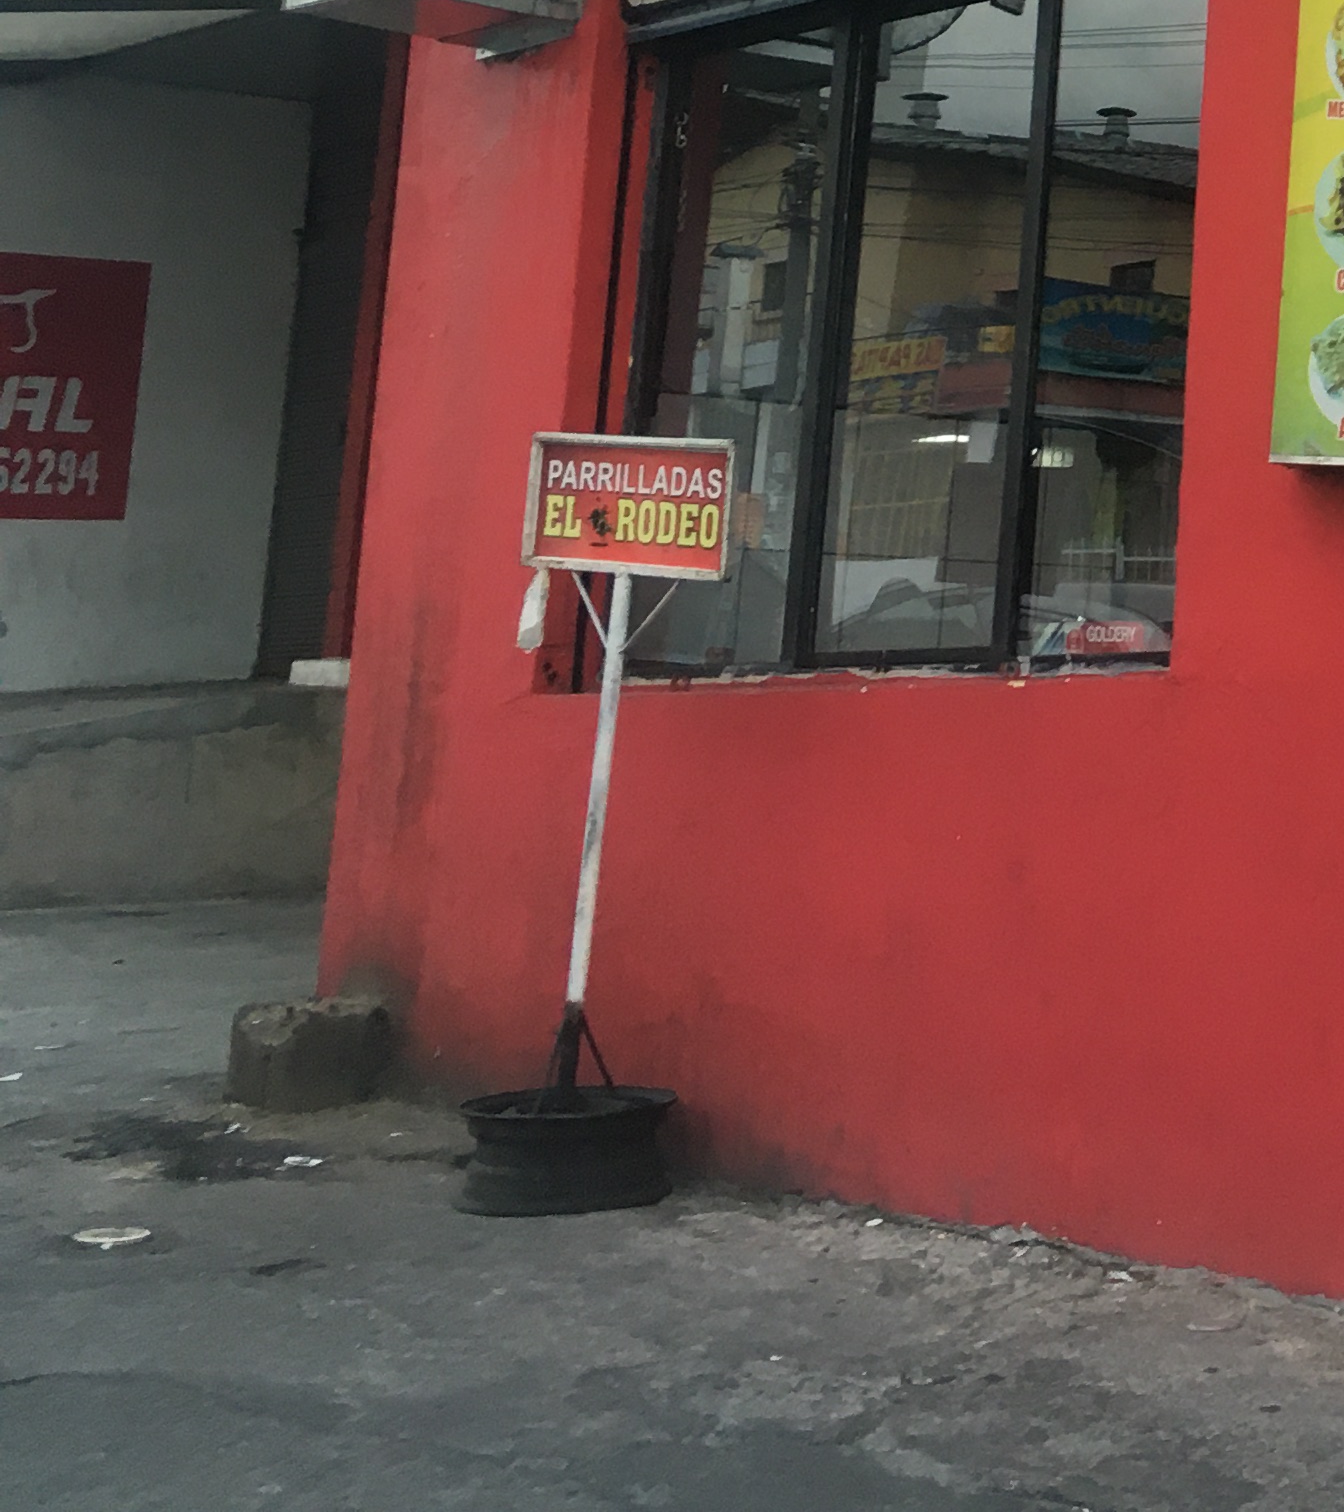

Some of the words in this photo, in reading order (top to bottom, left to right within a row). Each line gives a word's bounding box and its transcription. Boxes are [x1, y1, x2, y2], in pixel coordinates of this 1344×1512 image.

[547, 458, 723, 500] PARRILLADAS
[543, 494, 582, 539] EL
[615, 497, 720, 549] RODEO
